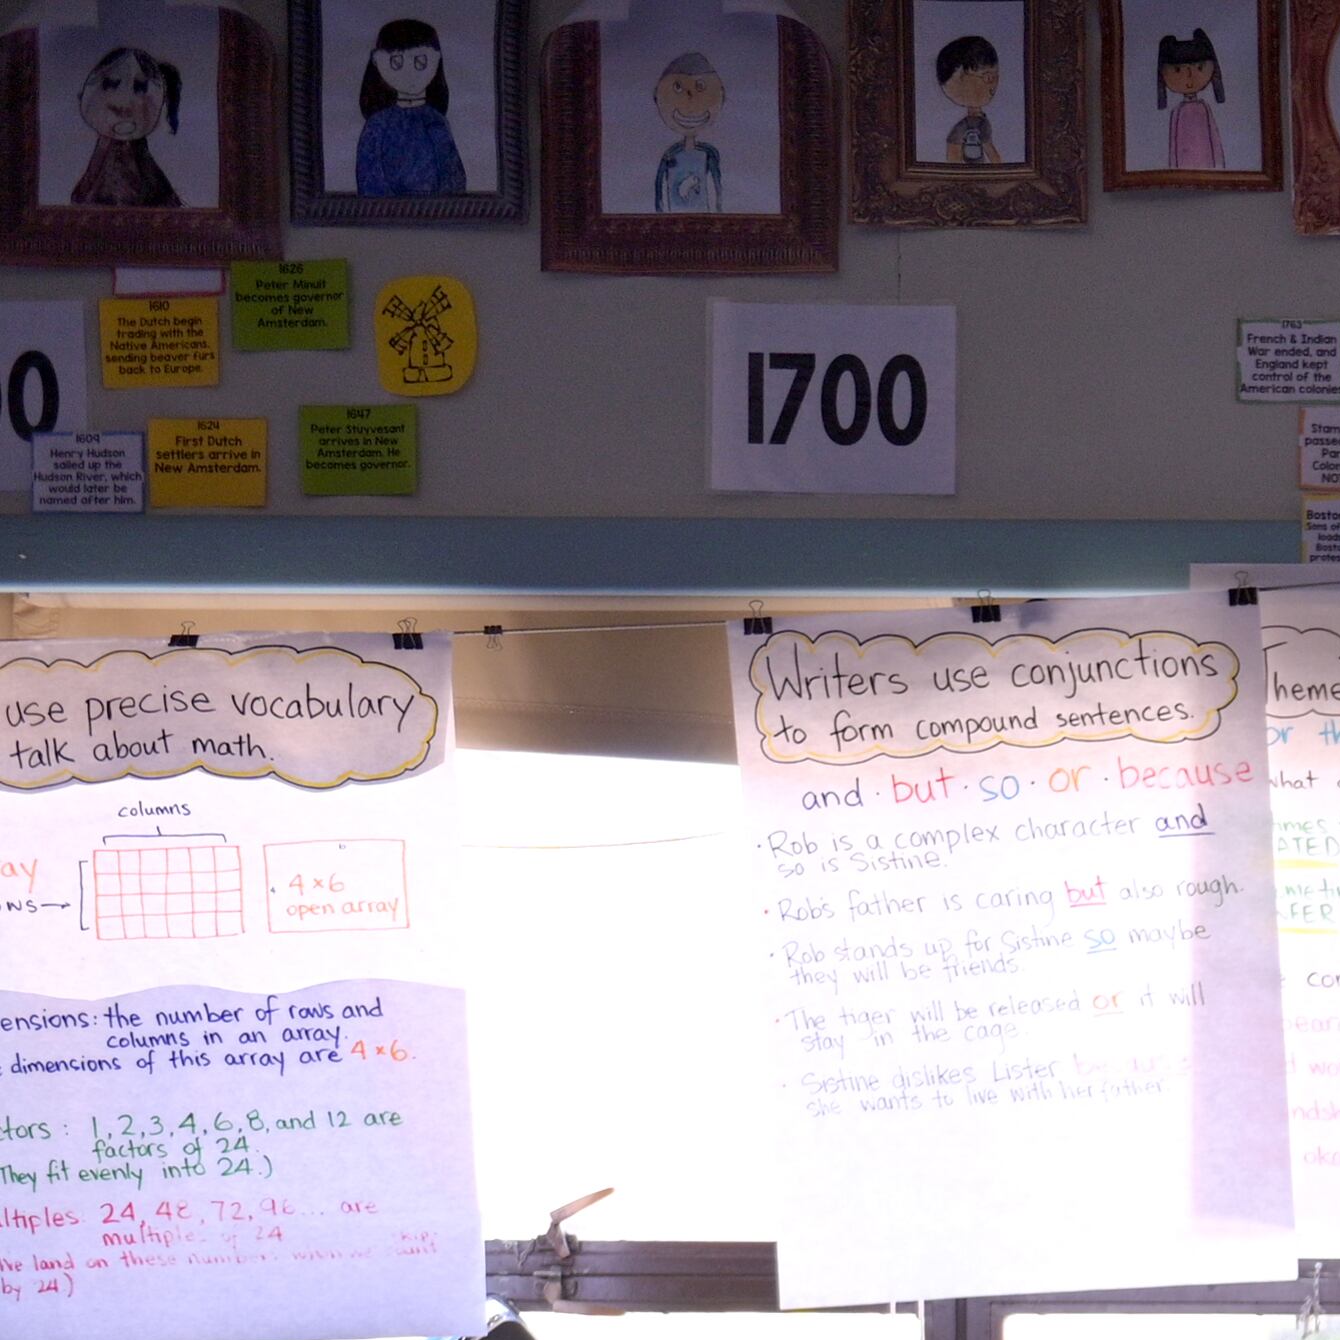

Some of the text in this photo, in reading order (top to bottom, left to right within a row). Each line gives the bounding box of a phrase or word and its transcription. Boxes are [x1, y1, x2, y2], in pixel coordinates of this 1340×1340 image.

[278, 263, 304, 274] 1626
[256, 280, 326, 290] Peter Minuit
[235, 292, 344, 305] becomes governor
[149, 300, 171, 311] 1610
[271, 305, 314, 316] of New
[117, 317, 203, 329] The Dutch begin
[117, 328, 204, 340] trading with the
[1247, 333, 1337, 344] French & Indian
[110, 341, 147, 351] Native
[1247, 347, 1270, 356] War
[1316, 347, 1337, 357] and
[105, 352, 215, 365] sending beaver furs
[118, 364, 145, 375] back
[150, 364, 161, 374] to
[1255, 359, 1328, 371] England kept
[1252, 372, 1332, 382] control of the
[1240, 384, 1296, 394] American
[0, 350, 59, 441] 0
[747, 351, 927, 446] 1700
[346, 409, 372, 420] 1647
[197, 421, 220, 431] 1624
[310, 423, 405, 434] Peter Stuyvesant
[175, 435, 243, 447] First Dutch
[318, 437, 399, 446] arrives in New
[156, 448, 262, 460] settlers arrive in
[387, 447, 401, 457] He
[154, 462, 262, 473] New Amsterdam.
[305, 459, 357, 471] becomes
[766, 638, 1220, 701] Writers use conjunctions
[5, 682, 414, 737] use precise vocabulary
[774, 702, 1196, 751] to form compound sentences.
[10, 730, 275, 770] talk about math.
[801, 755, 1255, 812] and but so or because
[1269, 769, 1320, 791] what
[117, 800, 191, 818] columns
[767, 804, 1209, 858] Rob is a complex character and
[285, 897, 400, 922] open array
[1, 994, 383, 1031] ensions: the number of rows and
[106, 1025, 349, 1050] columns in an array.
[10, 1046, 344, 1076] dimensions of this array are
